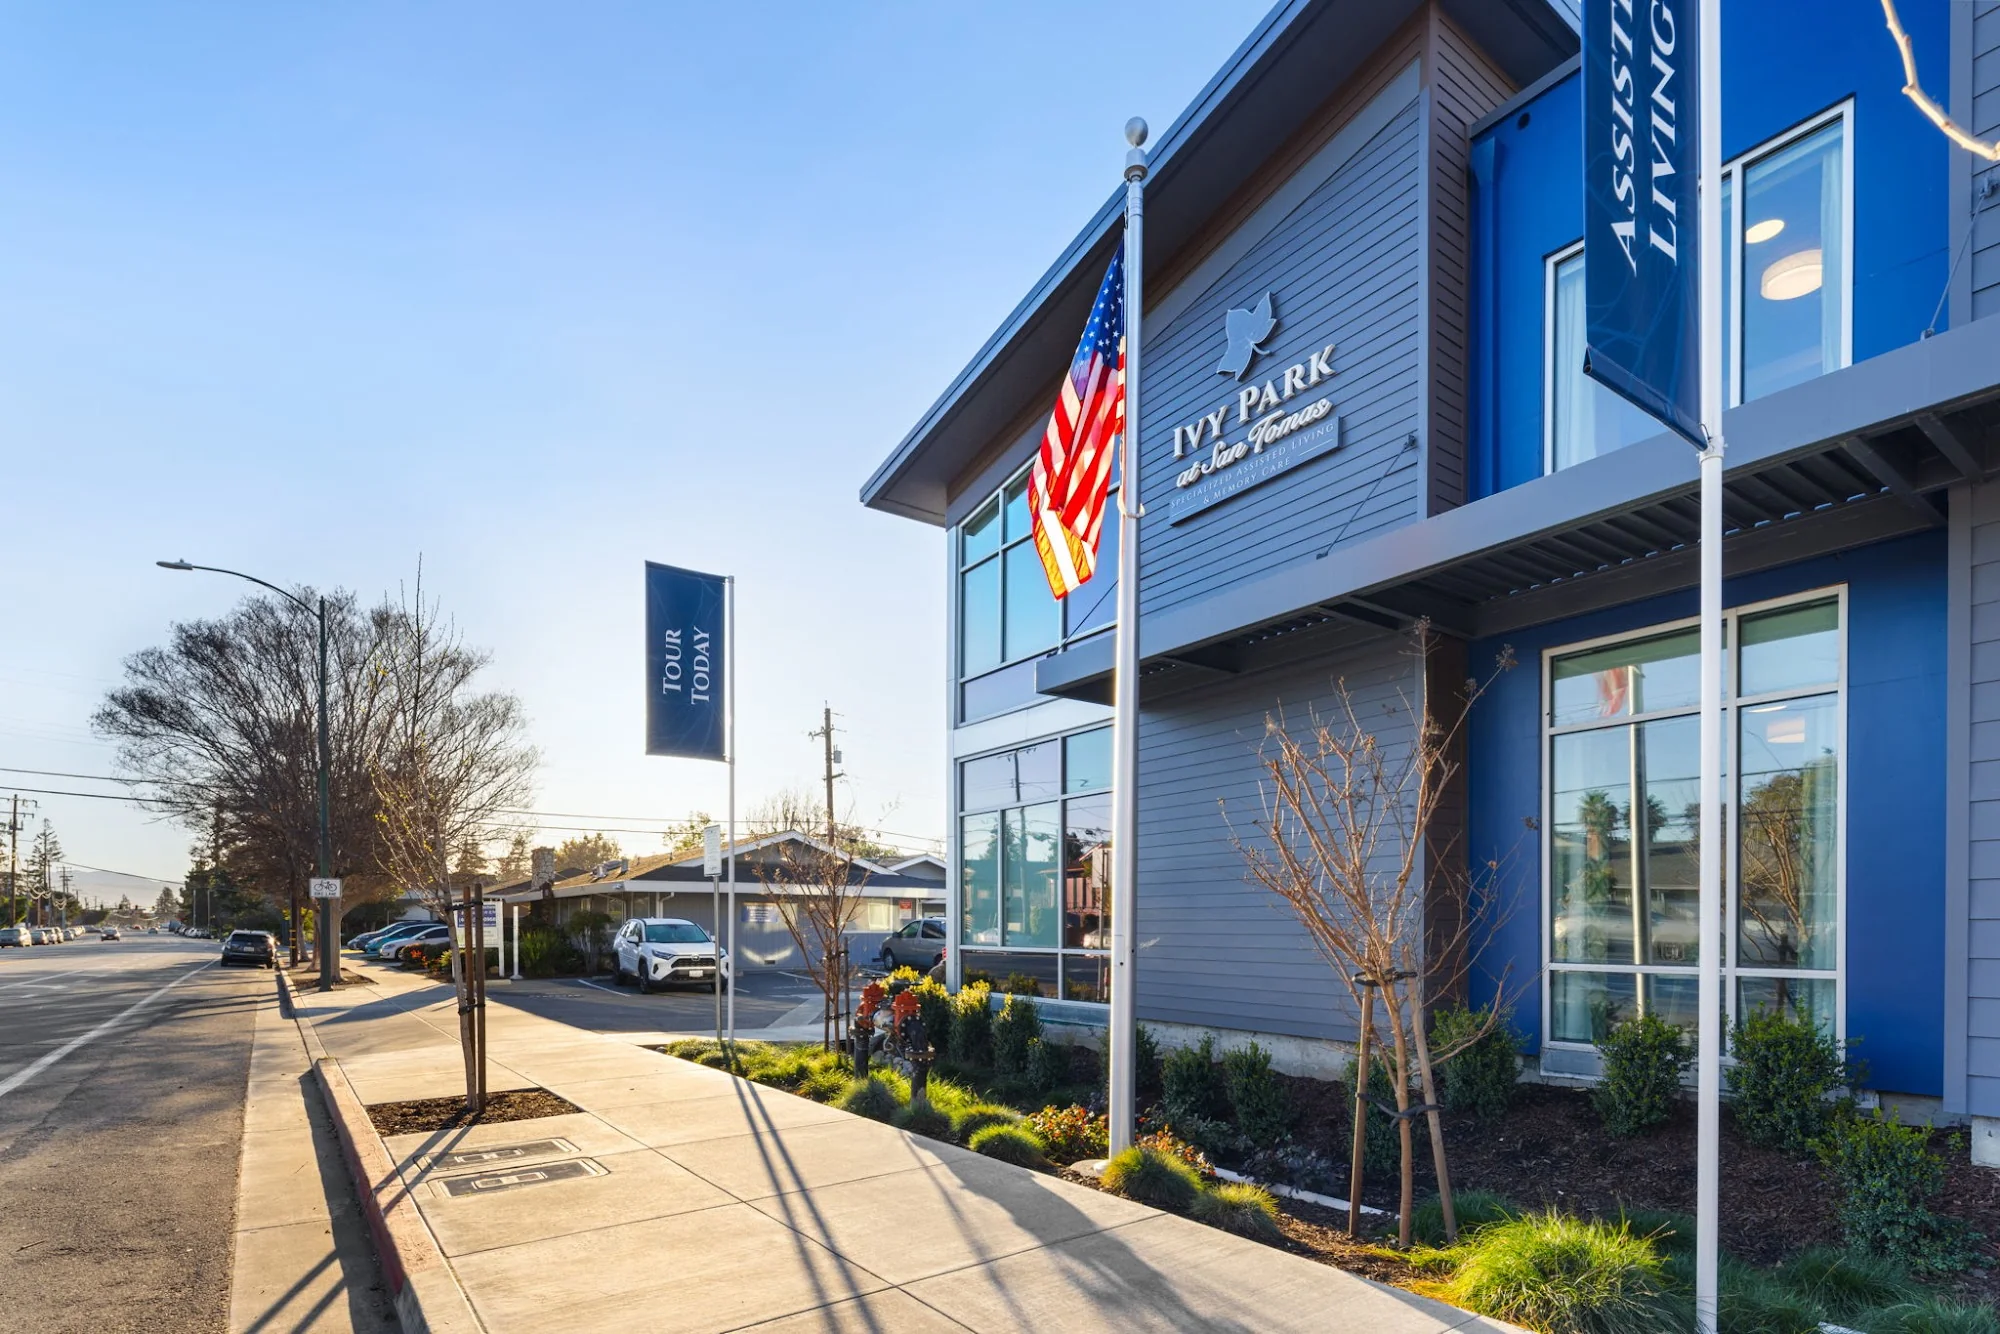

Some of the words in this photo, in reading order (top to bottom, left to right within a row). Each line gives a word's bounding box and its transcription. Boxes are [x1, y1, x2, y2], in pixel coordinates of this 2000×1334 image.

[1650, 0, 1678, 267] LIVING
[1172, 404, 1229, 459] IVY
[1237, 344, 1336, 424] PARK
[1176, 461, 1201, 488] at
[1201, 440, 1249, 474] San
[1247, 398, 1333, 454] Tomas
[1170, 473, 1232, 509] SPECIALIZED
[1236, 446, 1286, 476] ASSISTED
[1291, 423, 1334, 450] LIVING
[1203, 495, 1211, 505] &
[1213, 472, 1257, 499] MEMORY
[1261, 456, 1291, 476] CARE
[662, 628, 682, 694] TOUR
[691, 625, 710, 705] TODAY
